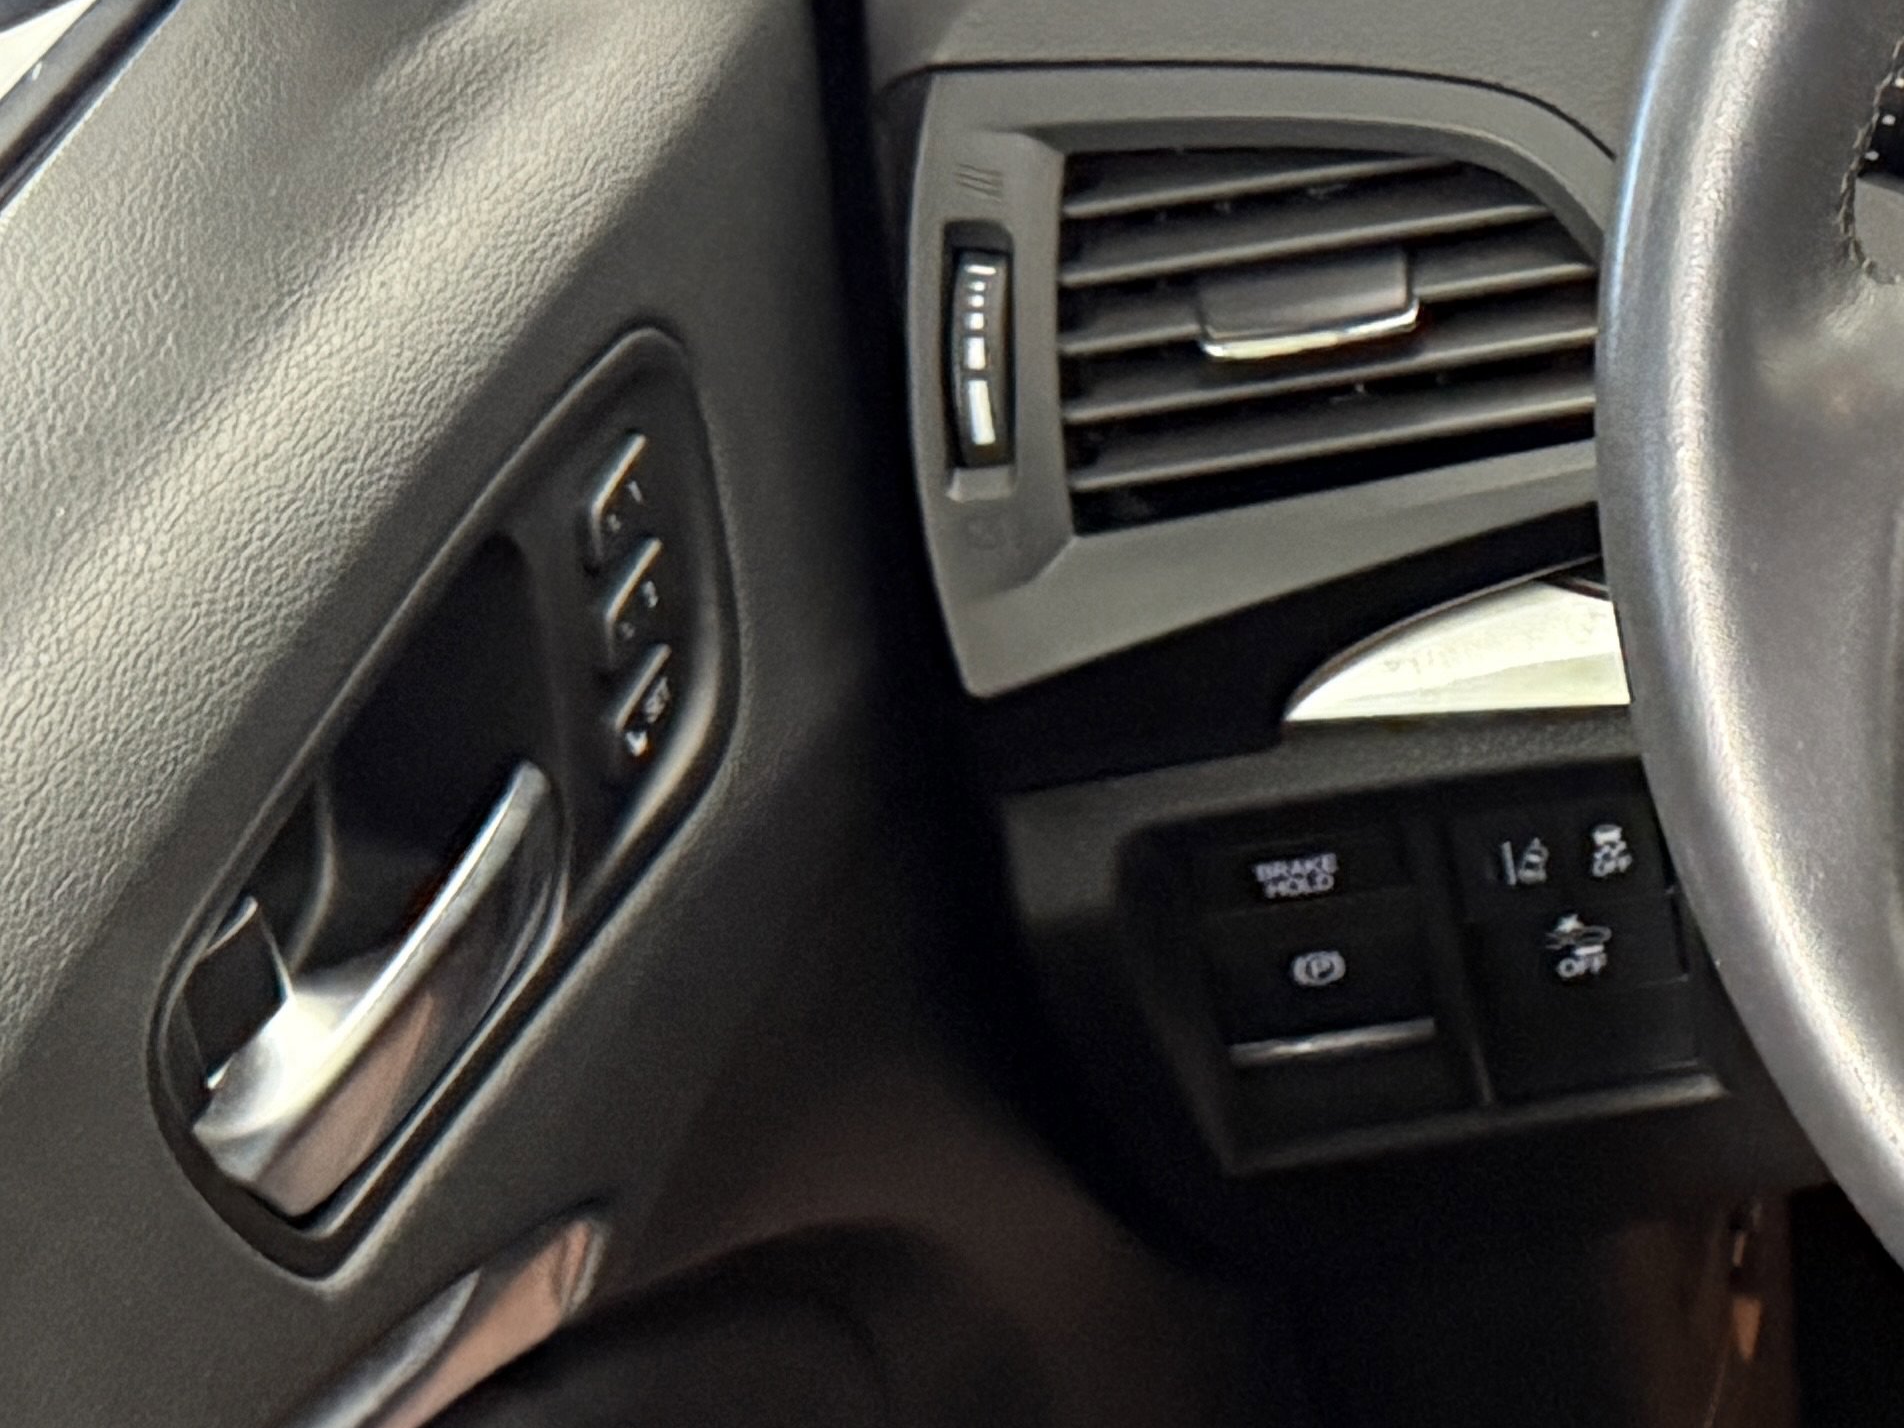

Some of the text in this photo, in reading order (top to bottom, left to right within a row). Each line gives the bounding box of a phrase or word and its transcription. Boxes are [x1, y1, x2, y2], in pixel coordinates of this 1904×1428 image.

[1256, 853, 1338, 882] BRAKE
[1264, 874, 1335, 899] HOLD
[1557, 953, 1608, 978] OFF
